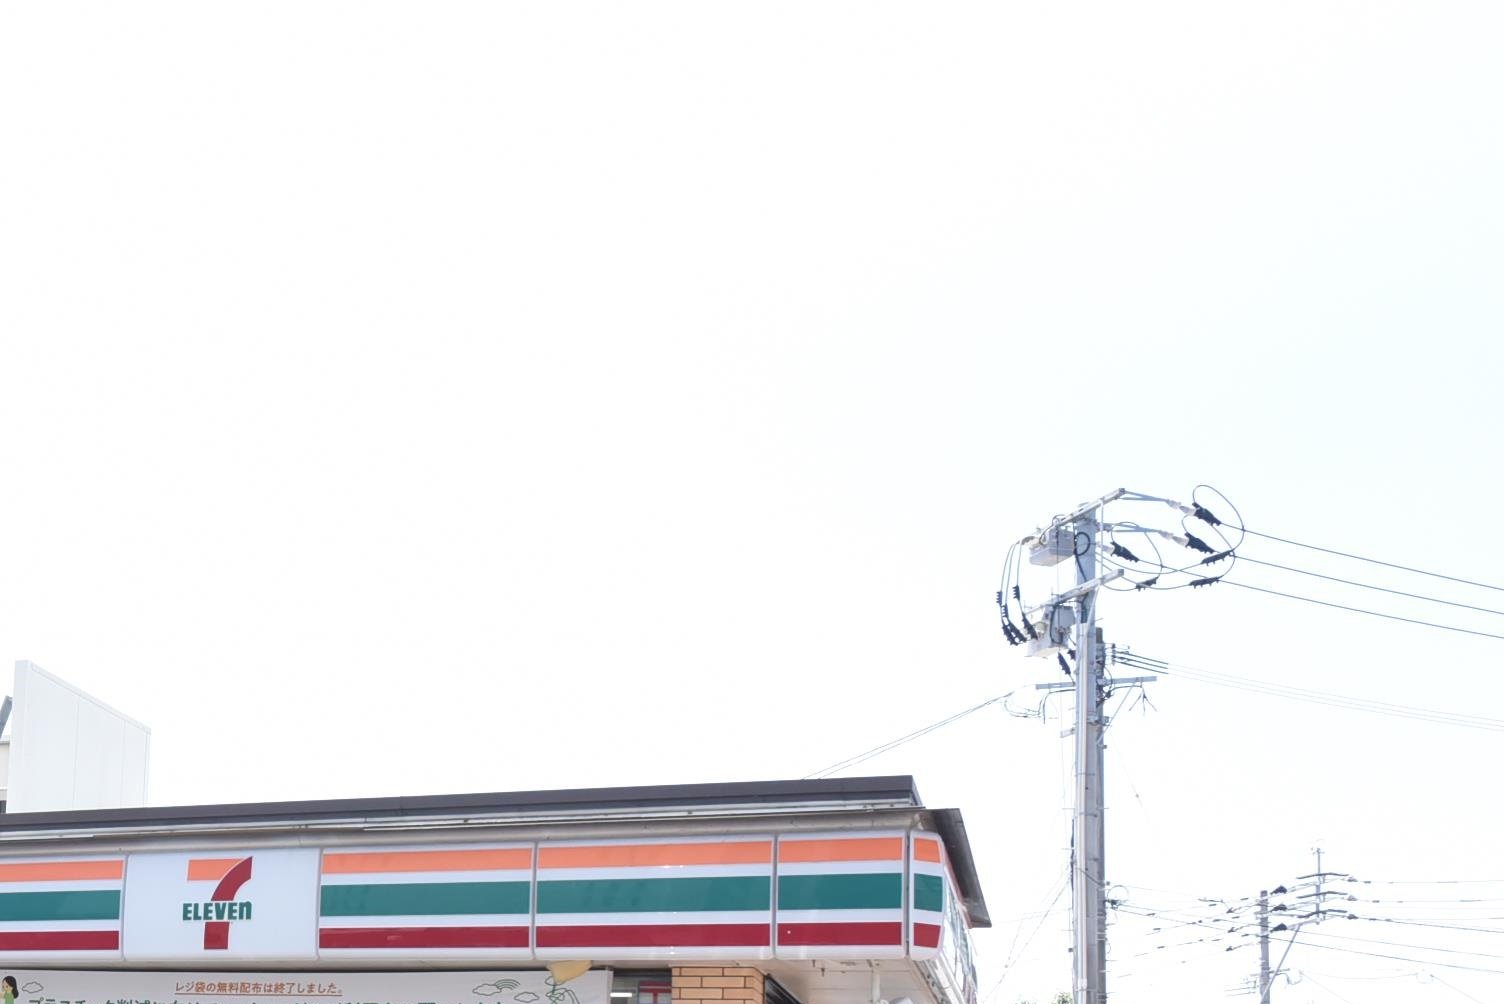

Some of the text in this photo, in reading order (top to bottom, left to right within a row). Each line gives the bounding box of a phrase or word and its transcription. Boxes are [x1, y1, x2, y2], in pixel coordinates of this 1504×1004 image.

[187, 856, 253, 950] 7
[175, 982, 343, 994] レジ袋の無料配布は終了しました。
